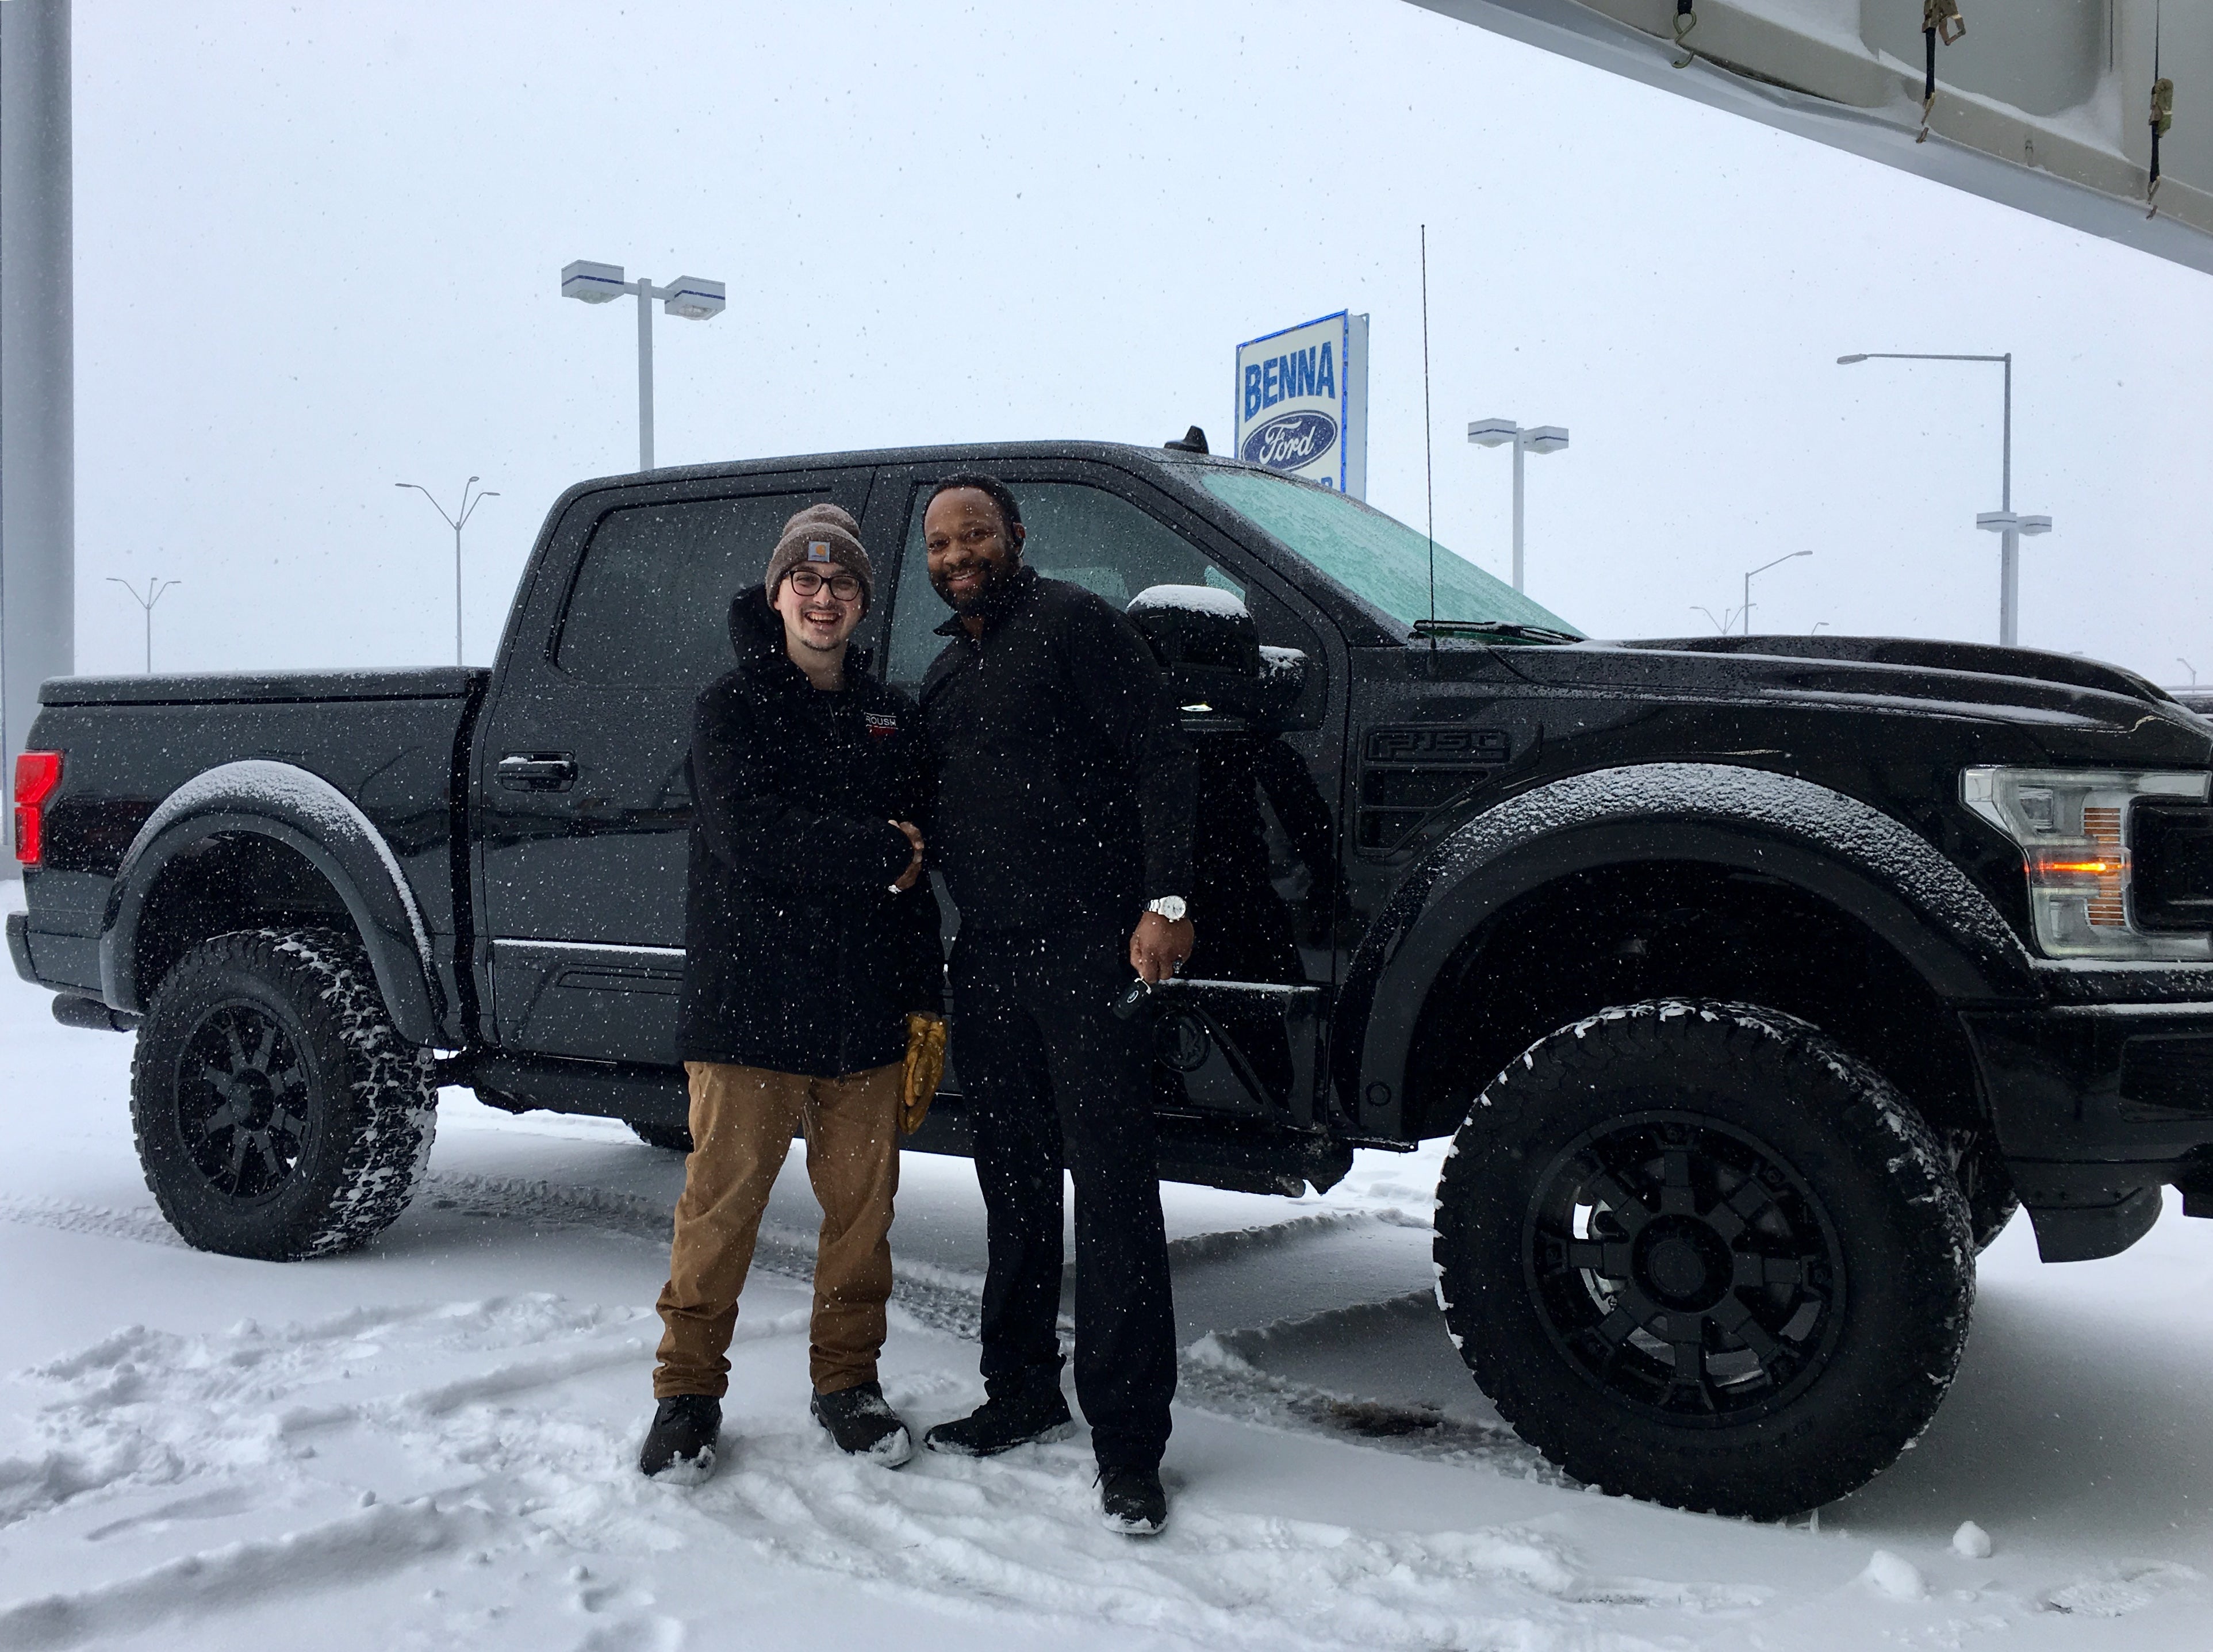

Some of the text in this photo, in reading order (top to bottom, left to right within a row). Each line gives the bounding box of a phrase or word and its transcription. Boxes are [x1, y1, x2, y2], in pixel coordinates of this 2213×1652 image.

[1244, 341, 1336, 423] BENNA
[1259, 420, 1316, 465] Ford
[865, 715, 896, 726] ROUSH
